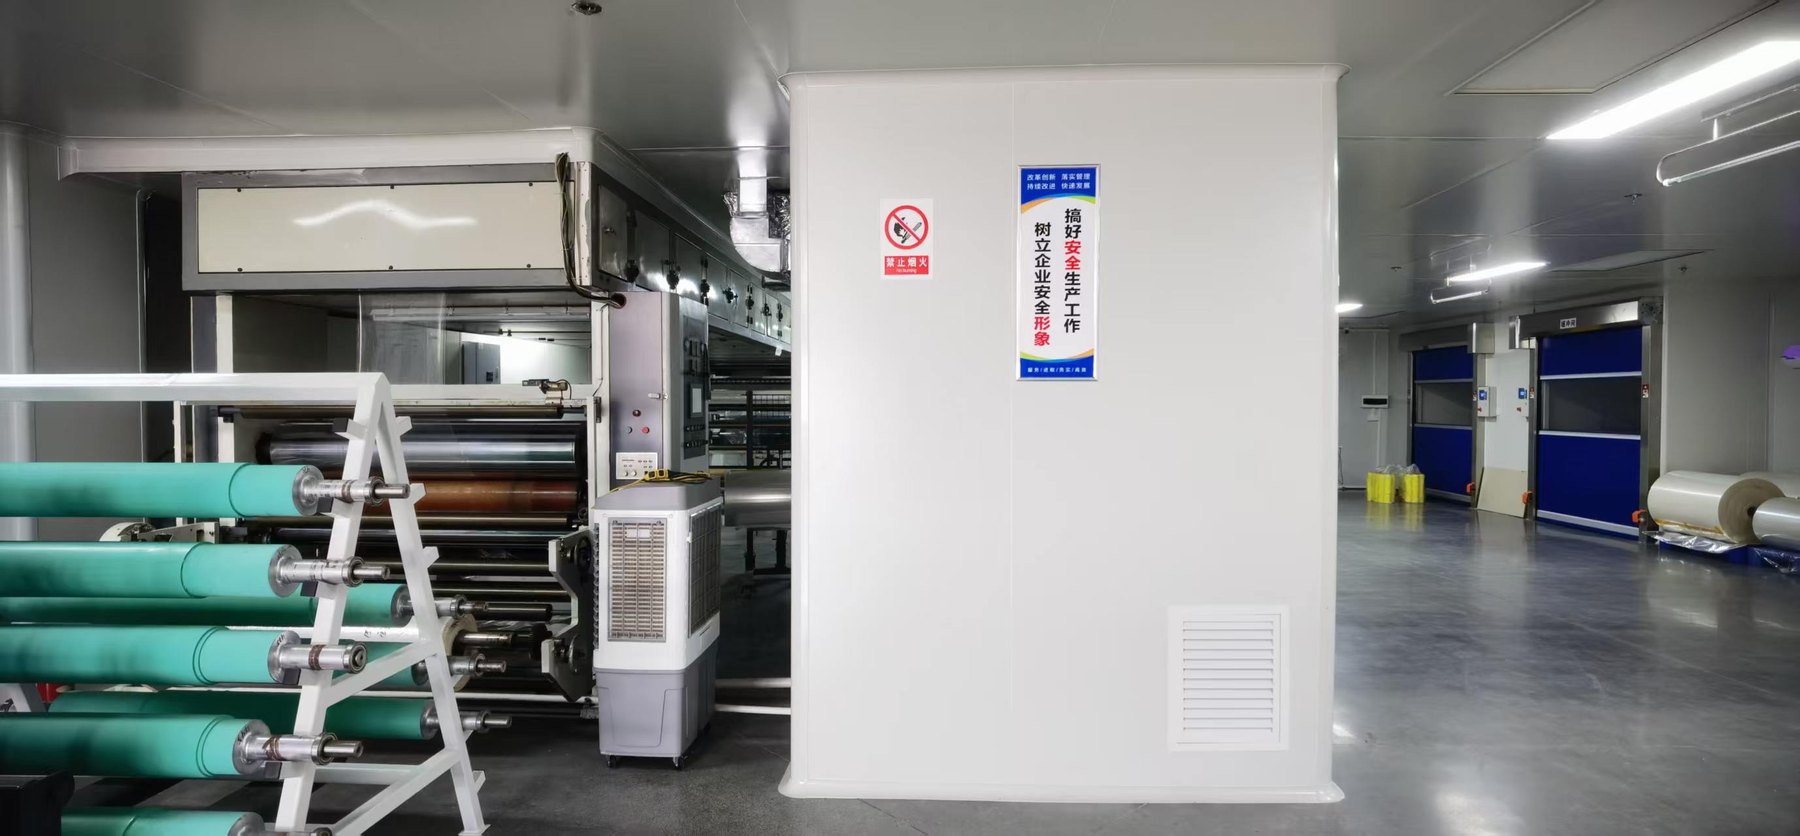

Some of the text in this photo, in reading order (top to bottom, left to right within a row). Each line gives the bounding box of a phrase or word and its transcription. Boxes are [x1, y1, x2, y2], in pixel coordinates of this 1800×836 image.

[1026, 172, 1091, 181] 改革创新 落实管理
[1026, 181, 1091, 190] 持续改进 快速发展
[886, 256, 928, 267] 禁止烟火
[1064, 207, 1082, 333] 搞好安全生产工作
[1033, 221, 1052, 346] 树立企业安全形象
